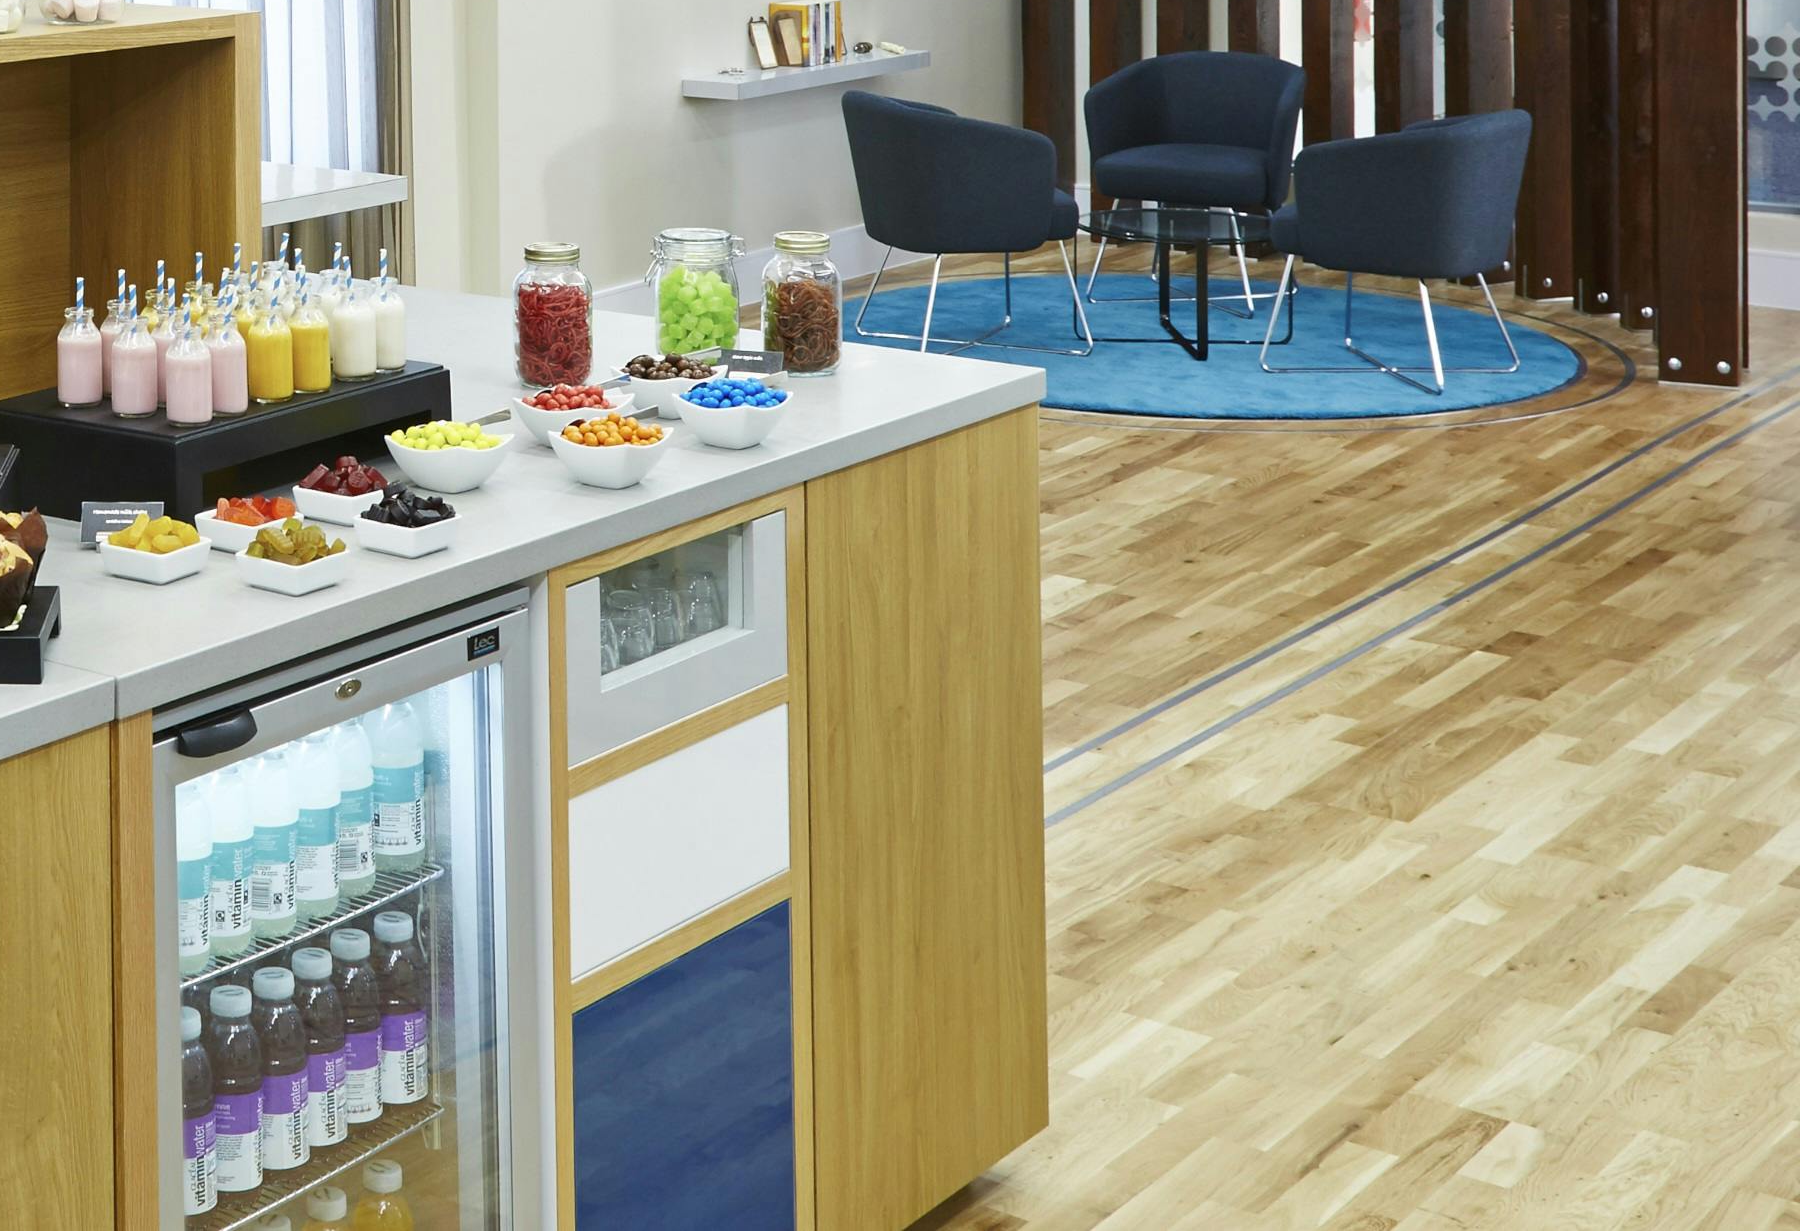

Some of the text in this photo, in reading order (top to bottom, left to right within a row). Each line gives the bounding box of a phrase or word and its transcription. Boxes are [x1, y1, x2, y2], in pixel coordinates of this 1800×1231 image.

[403, 1021, 415, 1096] vitaminwater
[291, 1080, 302, 1160] vitaminwater
[324, 1059, 336, 1139] vitaminwater
[194, 1124, 206, 1207] vitaminwater
